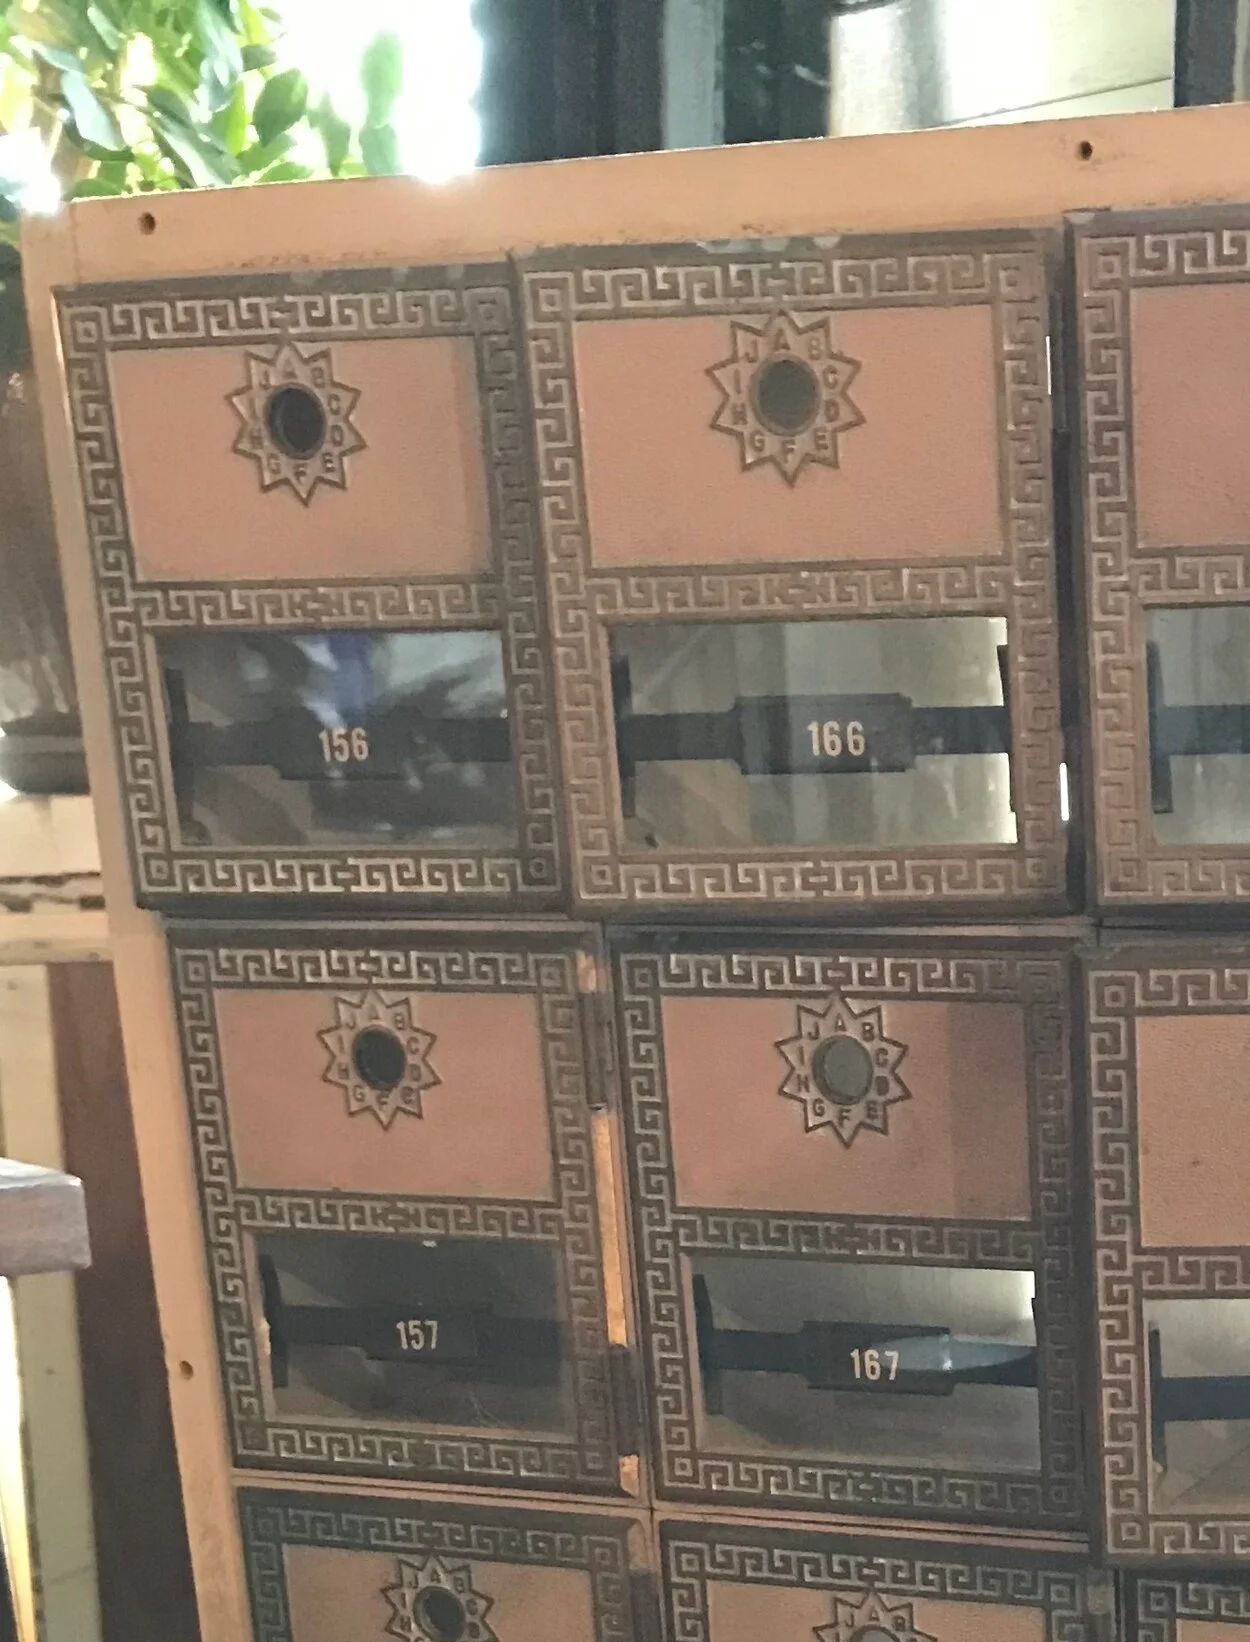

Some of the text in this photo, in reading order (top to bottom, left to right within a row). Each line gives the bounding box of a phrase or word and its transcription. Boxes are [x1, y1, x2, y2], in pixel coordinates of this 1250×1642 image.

[319, 727, 369, 762] 156
[807, 721, 865, 756] 166
[396, 1320, 438, 1350] 157
[850, 1349, 899, 1380] 167
